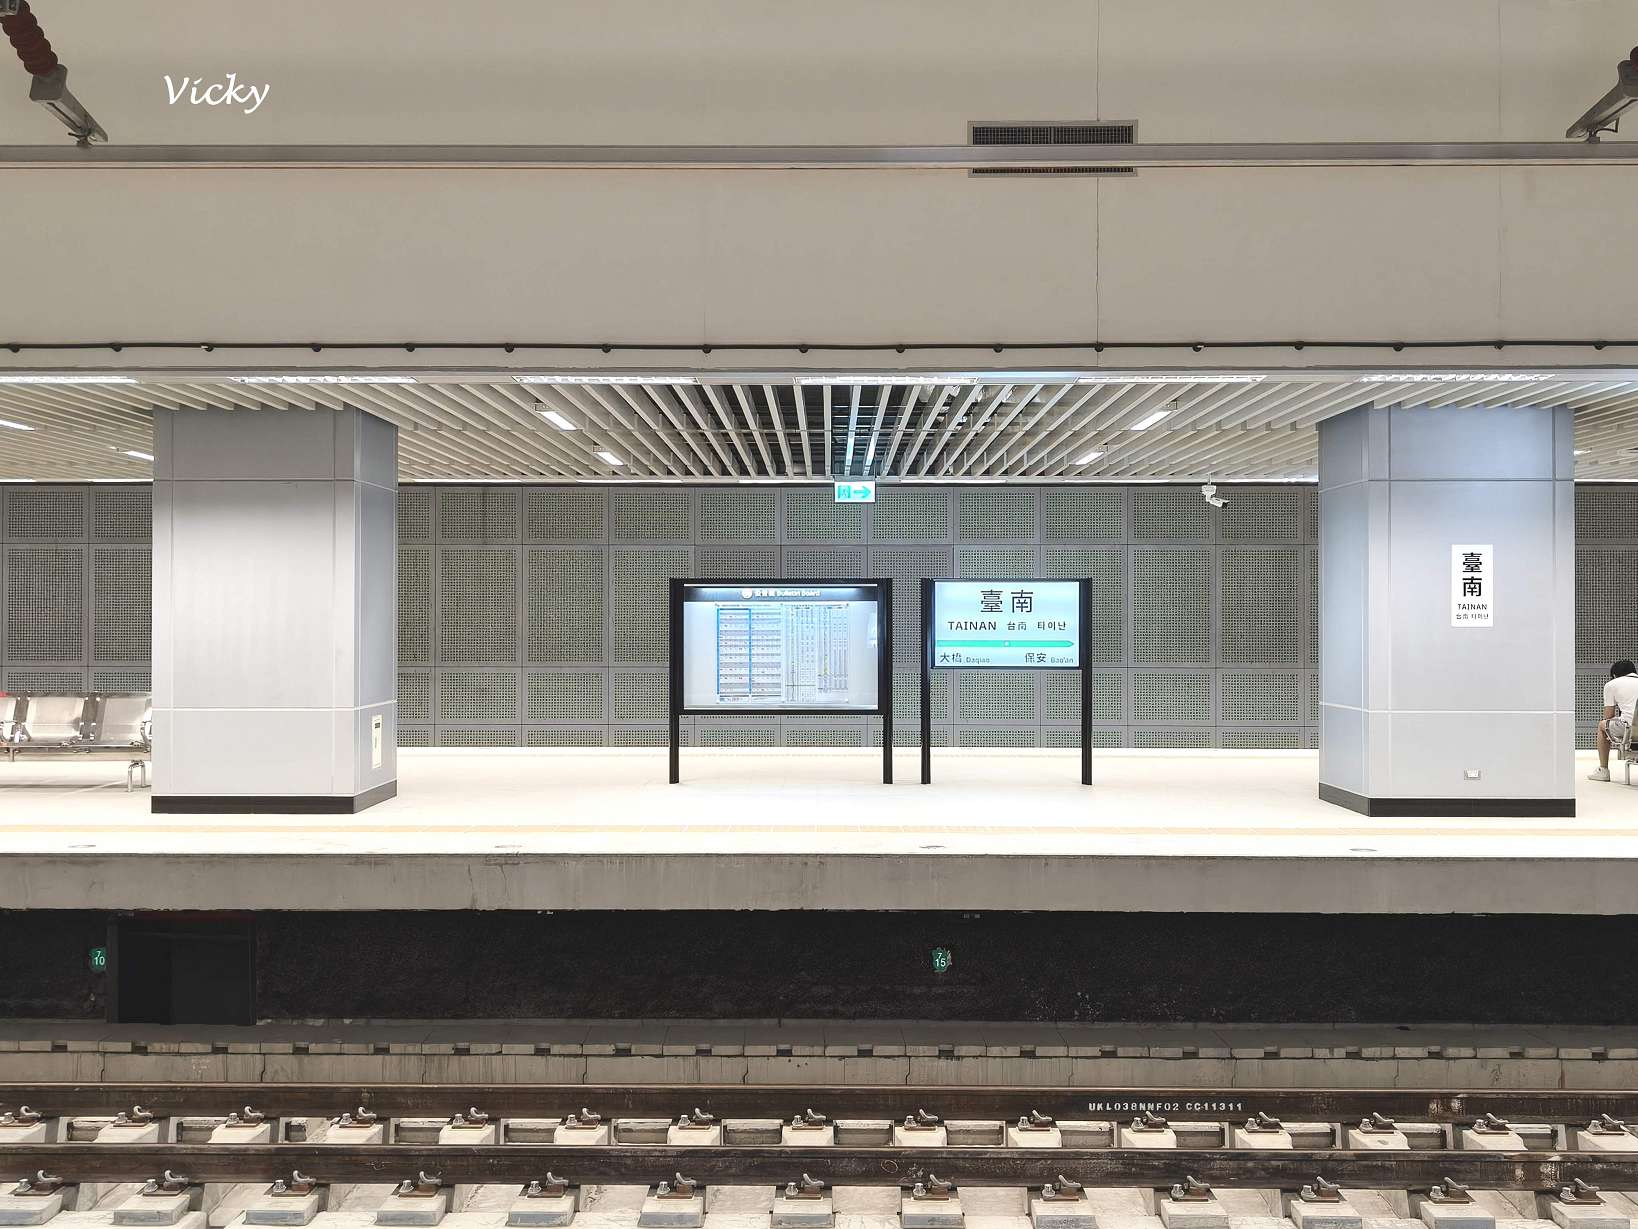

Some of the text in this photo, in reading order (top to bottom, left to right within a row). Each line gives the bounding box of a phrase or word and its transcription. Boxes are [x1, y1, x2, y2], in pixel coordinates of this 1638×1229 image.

[1462, 552, 1482, 597] 臺南
[980, 589, 1034, 613] 臺南
[948, 621, 1066, 631] TAINAN 台南 타이난
[1025, 653, 1047, 663] 保安
[94, 956, 105, 966] 10
[935, 958, 946, 967] 15
